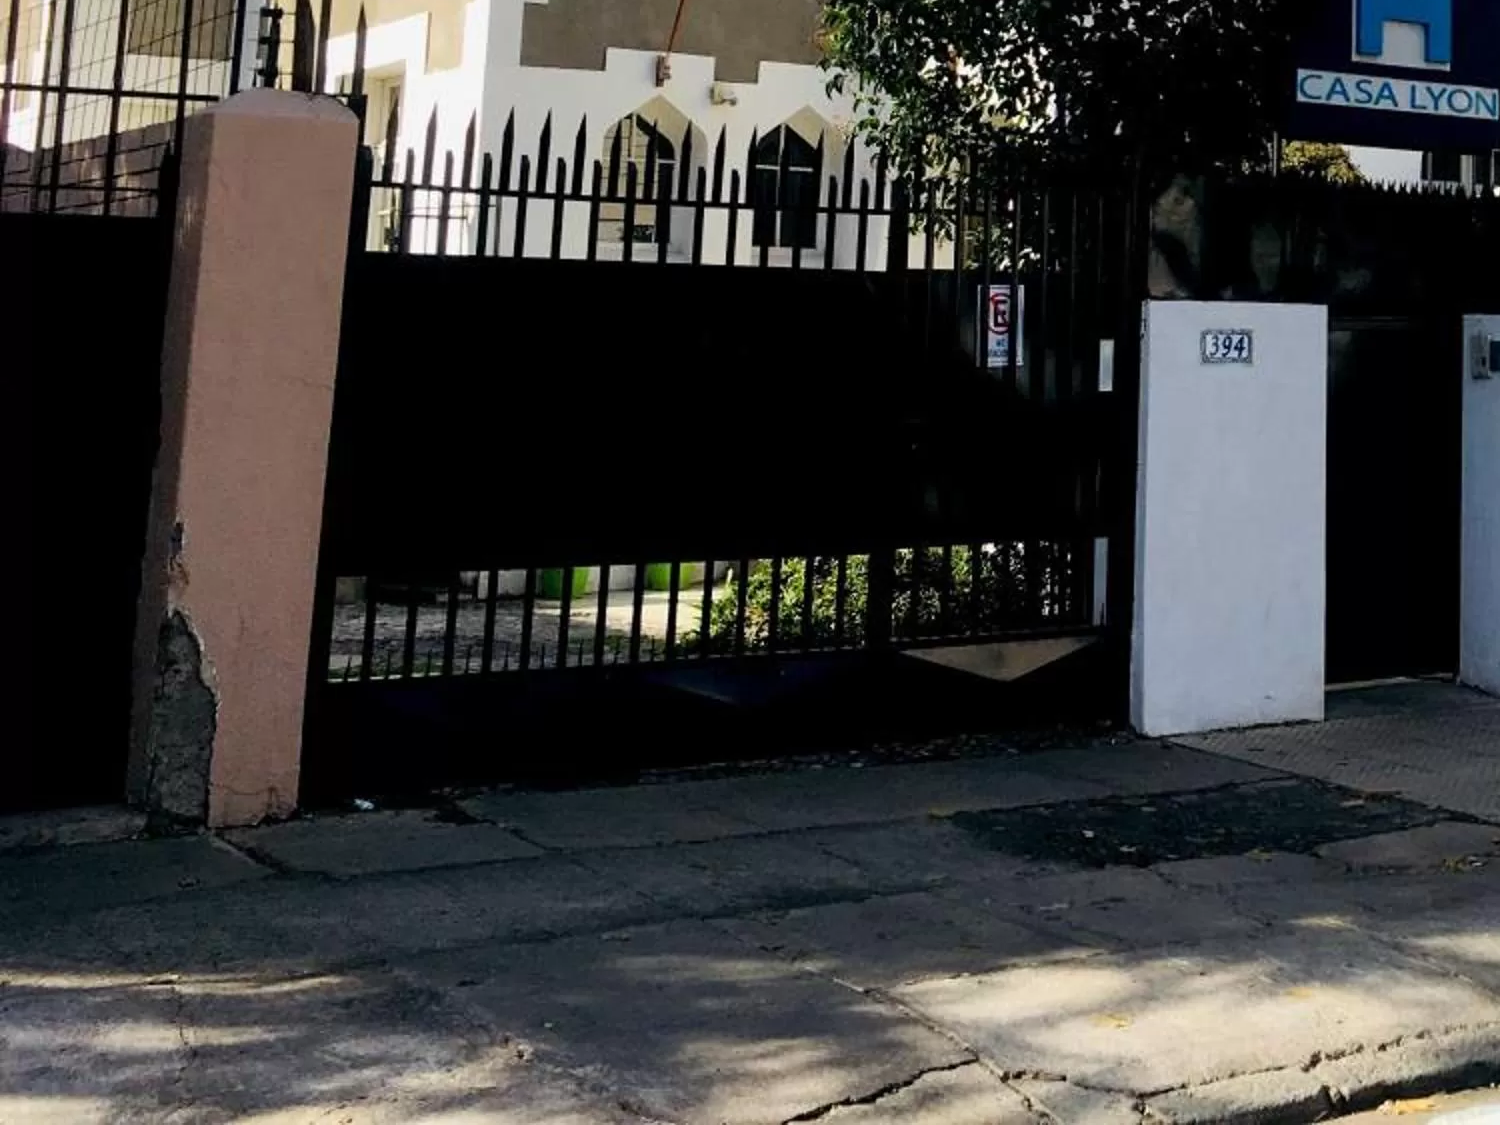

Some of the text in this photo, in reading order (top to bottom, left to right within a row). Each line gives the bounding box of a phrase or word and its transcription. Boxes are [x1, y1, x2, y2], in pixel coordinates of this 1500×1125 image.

[1299, 74, 1498, 118] CASA LYON
[1209, 334, 1246, 358] 394
